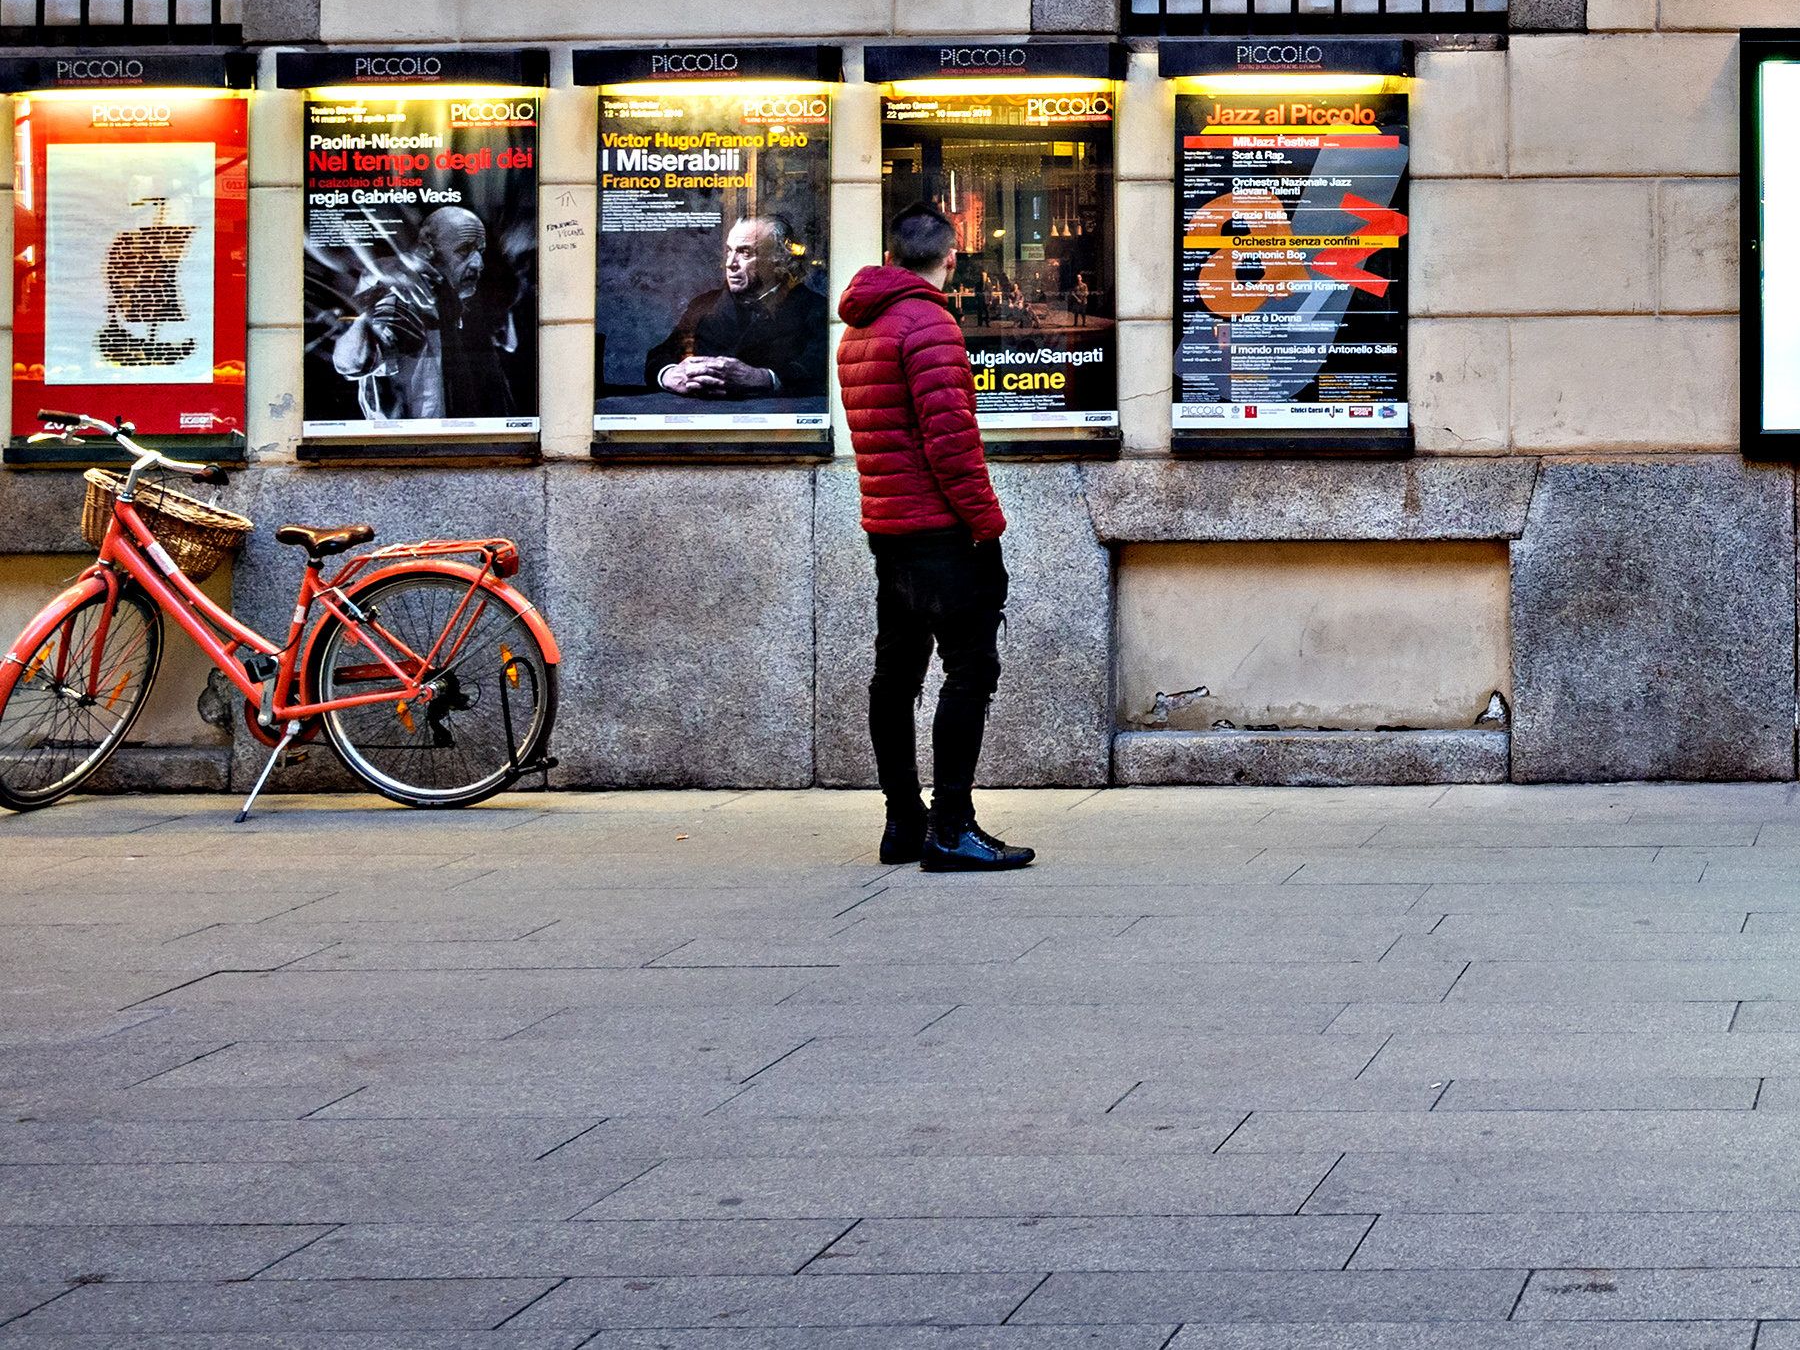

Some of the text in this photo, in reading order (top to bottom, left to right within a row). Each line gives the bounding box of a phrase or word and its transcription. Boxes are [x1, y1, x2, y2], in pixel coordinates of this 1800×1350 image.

[652, 53, 738, 72] PICCOLO
[940, 49, 1026, 66] PICCOLO
[1237, 46, 1322, 63] PICCOLO
[57, 60, 143, 78] PICCOLO
[355, 57, 441, 75] PICCOLO
[92, 105, 171, 122] PICCOLO
[451, 103, 534, 121] PICCOLO
[743, 99, 827, 117] PICCOLO
[886, 110, 897, 119] 22
[1027, 98, 1109, 115] PICCOLO
[1207, 104, 1376, 125] Jazz al Piccolo
[310, 133, 443, 150] Paolini-Niccolini
[602, 133, 651, 147] Victor
[655, 132, 764, 150] Hugo/Franco
[1278, 135, 1319, 147] Festival
[309, 147, 533, 175] Nel tempo degli dèi
[602, 148, 740, 172] I Miserabili
[1232, 151, 1284, 161] Scat & Rap
[318, 178, 370, 188] calzolaio
[373, 177, 383, 187] di
[386, 177, 423, 187] Ulisse
[602, 173, 753, 188] Franco Branciaroli
[1232, 178, 1352, 187] Orchestra Nazionale Jazz
[309, 188, 462, 207] regia Gabriele Vacis
[1232, 187, 1268, 196] Giovani
[1269, 187, 1301, 196] Talenti
[1232, 211, 1288, 220] Grazie Italia
[1232, 237, 1287, 246] Orchestra
[1289, 238, 1321, 246] senza
[1323, 237, 1360, 246] confini
[1231, 250, 1285, 261] Symphonic
[1286, 251, 1306, 260] Bop
[1231, 282, 1244, 291] Lo
[1245, 282, 1274, 293] Swing
[1276, 282, 1285, 291] di
[1314, 282, 1350, 291] Kramer
[1239, 314, 1261, 323] Jazz
[1270, 314, 1302, 323] Donna
[1239, 345, 1269, 354] mondo
[1271, 345, 1316, 354] musicale
[1317, 345, 1326, 354] di
[1328, 345, 1373, 354] Antonello
[1374, 345, 1398, 354] Salis
[973, 368, 1066, 390] di cane
[1181, 406, 1224, 415] PICCOLO
